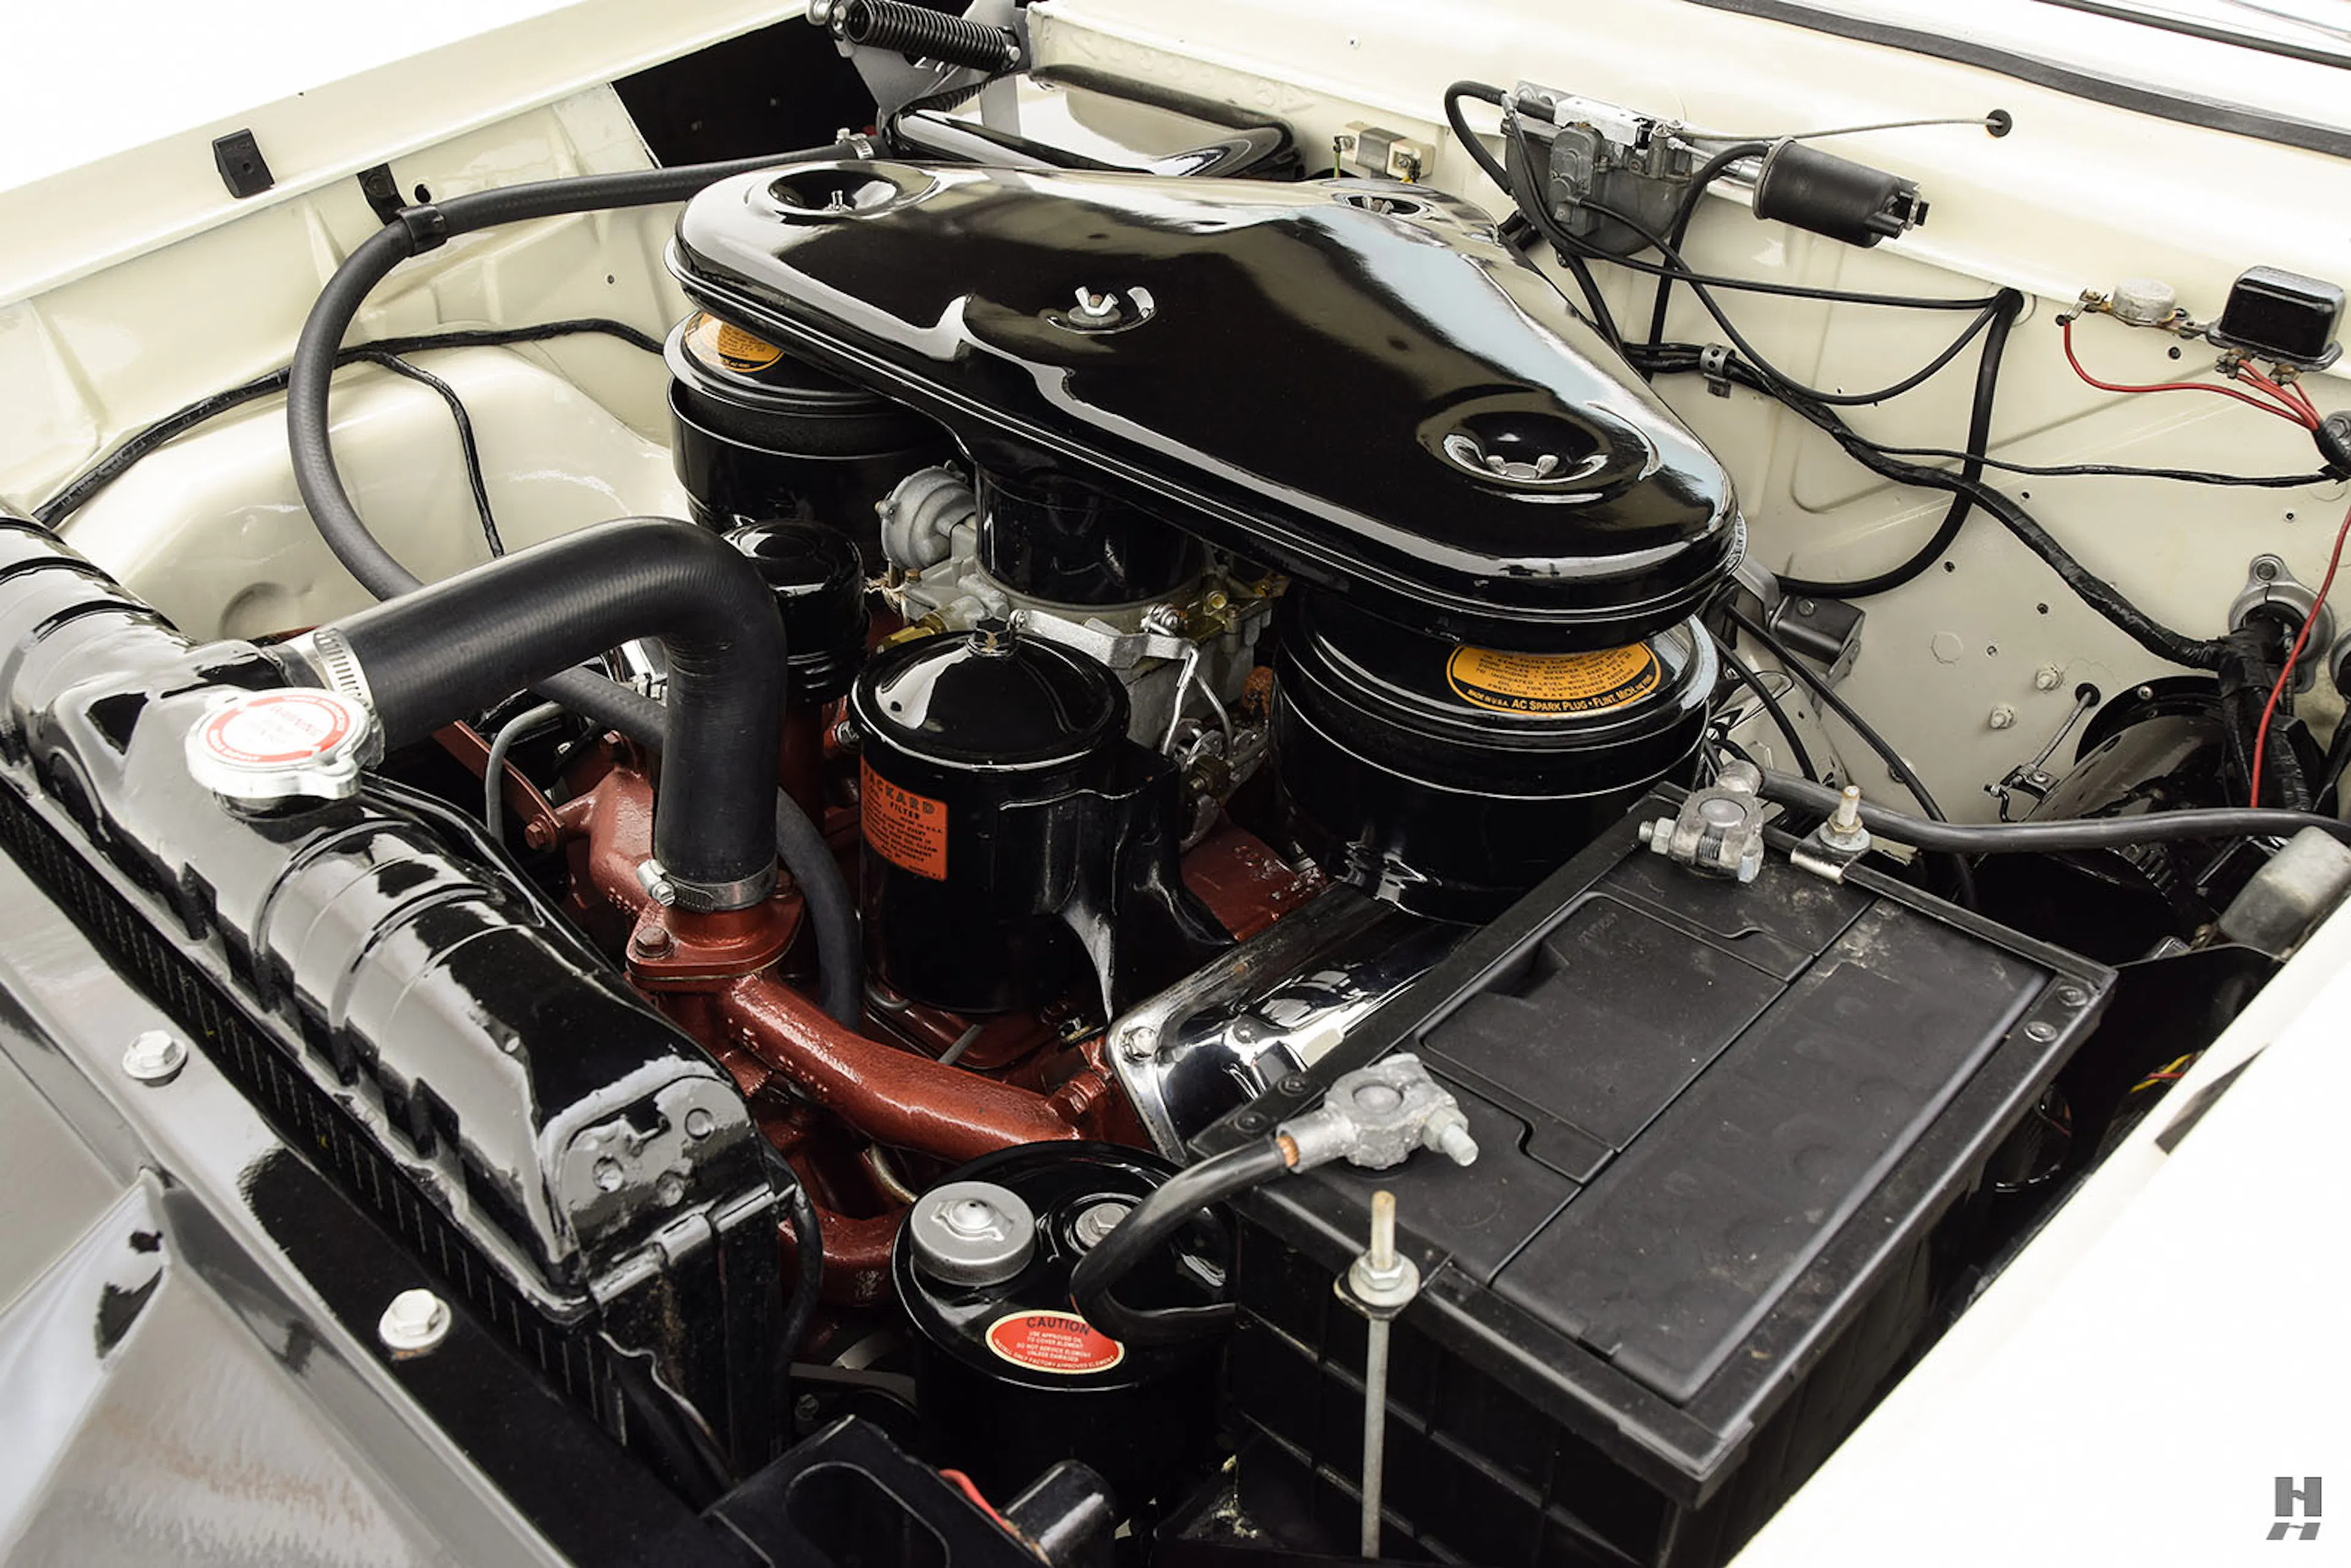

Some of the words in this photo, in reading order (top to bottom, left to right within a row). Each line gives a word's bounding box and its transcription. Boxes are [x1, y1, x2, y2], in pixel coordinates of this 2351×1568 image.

[1511, 699, 1528, 710] AC
[1529, 700, 1561, 712] SPARK
[1562, 701, 1588, 711] PLUG
[864, 763, 936, 816] PACKARD
[890, 800, 920, 820] FILTER
[1026, 1316, 1090, 1335] CAUTION
[1042, 1332, 1073, 1341] APPROVED
[1057, 1340, 1083, 1349] ELEMENT
[1089, 1355, 1114, 1367] ELEMENT
